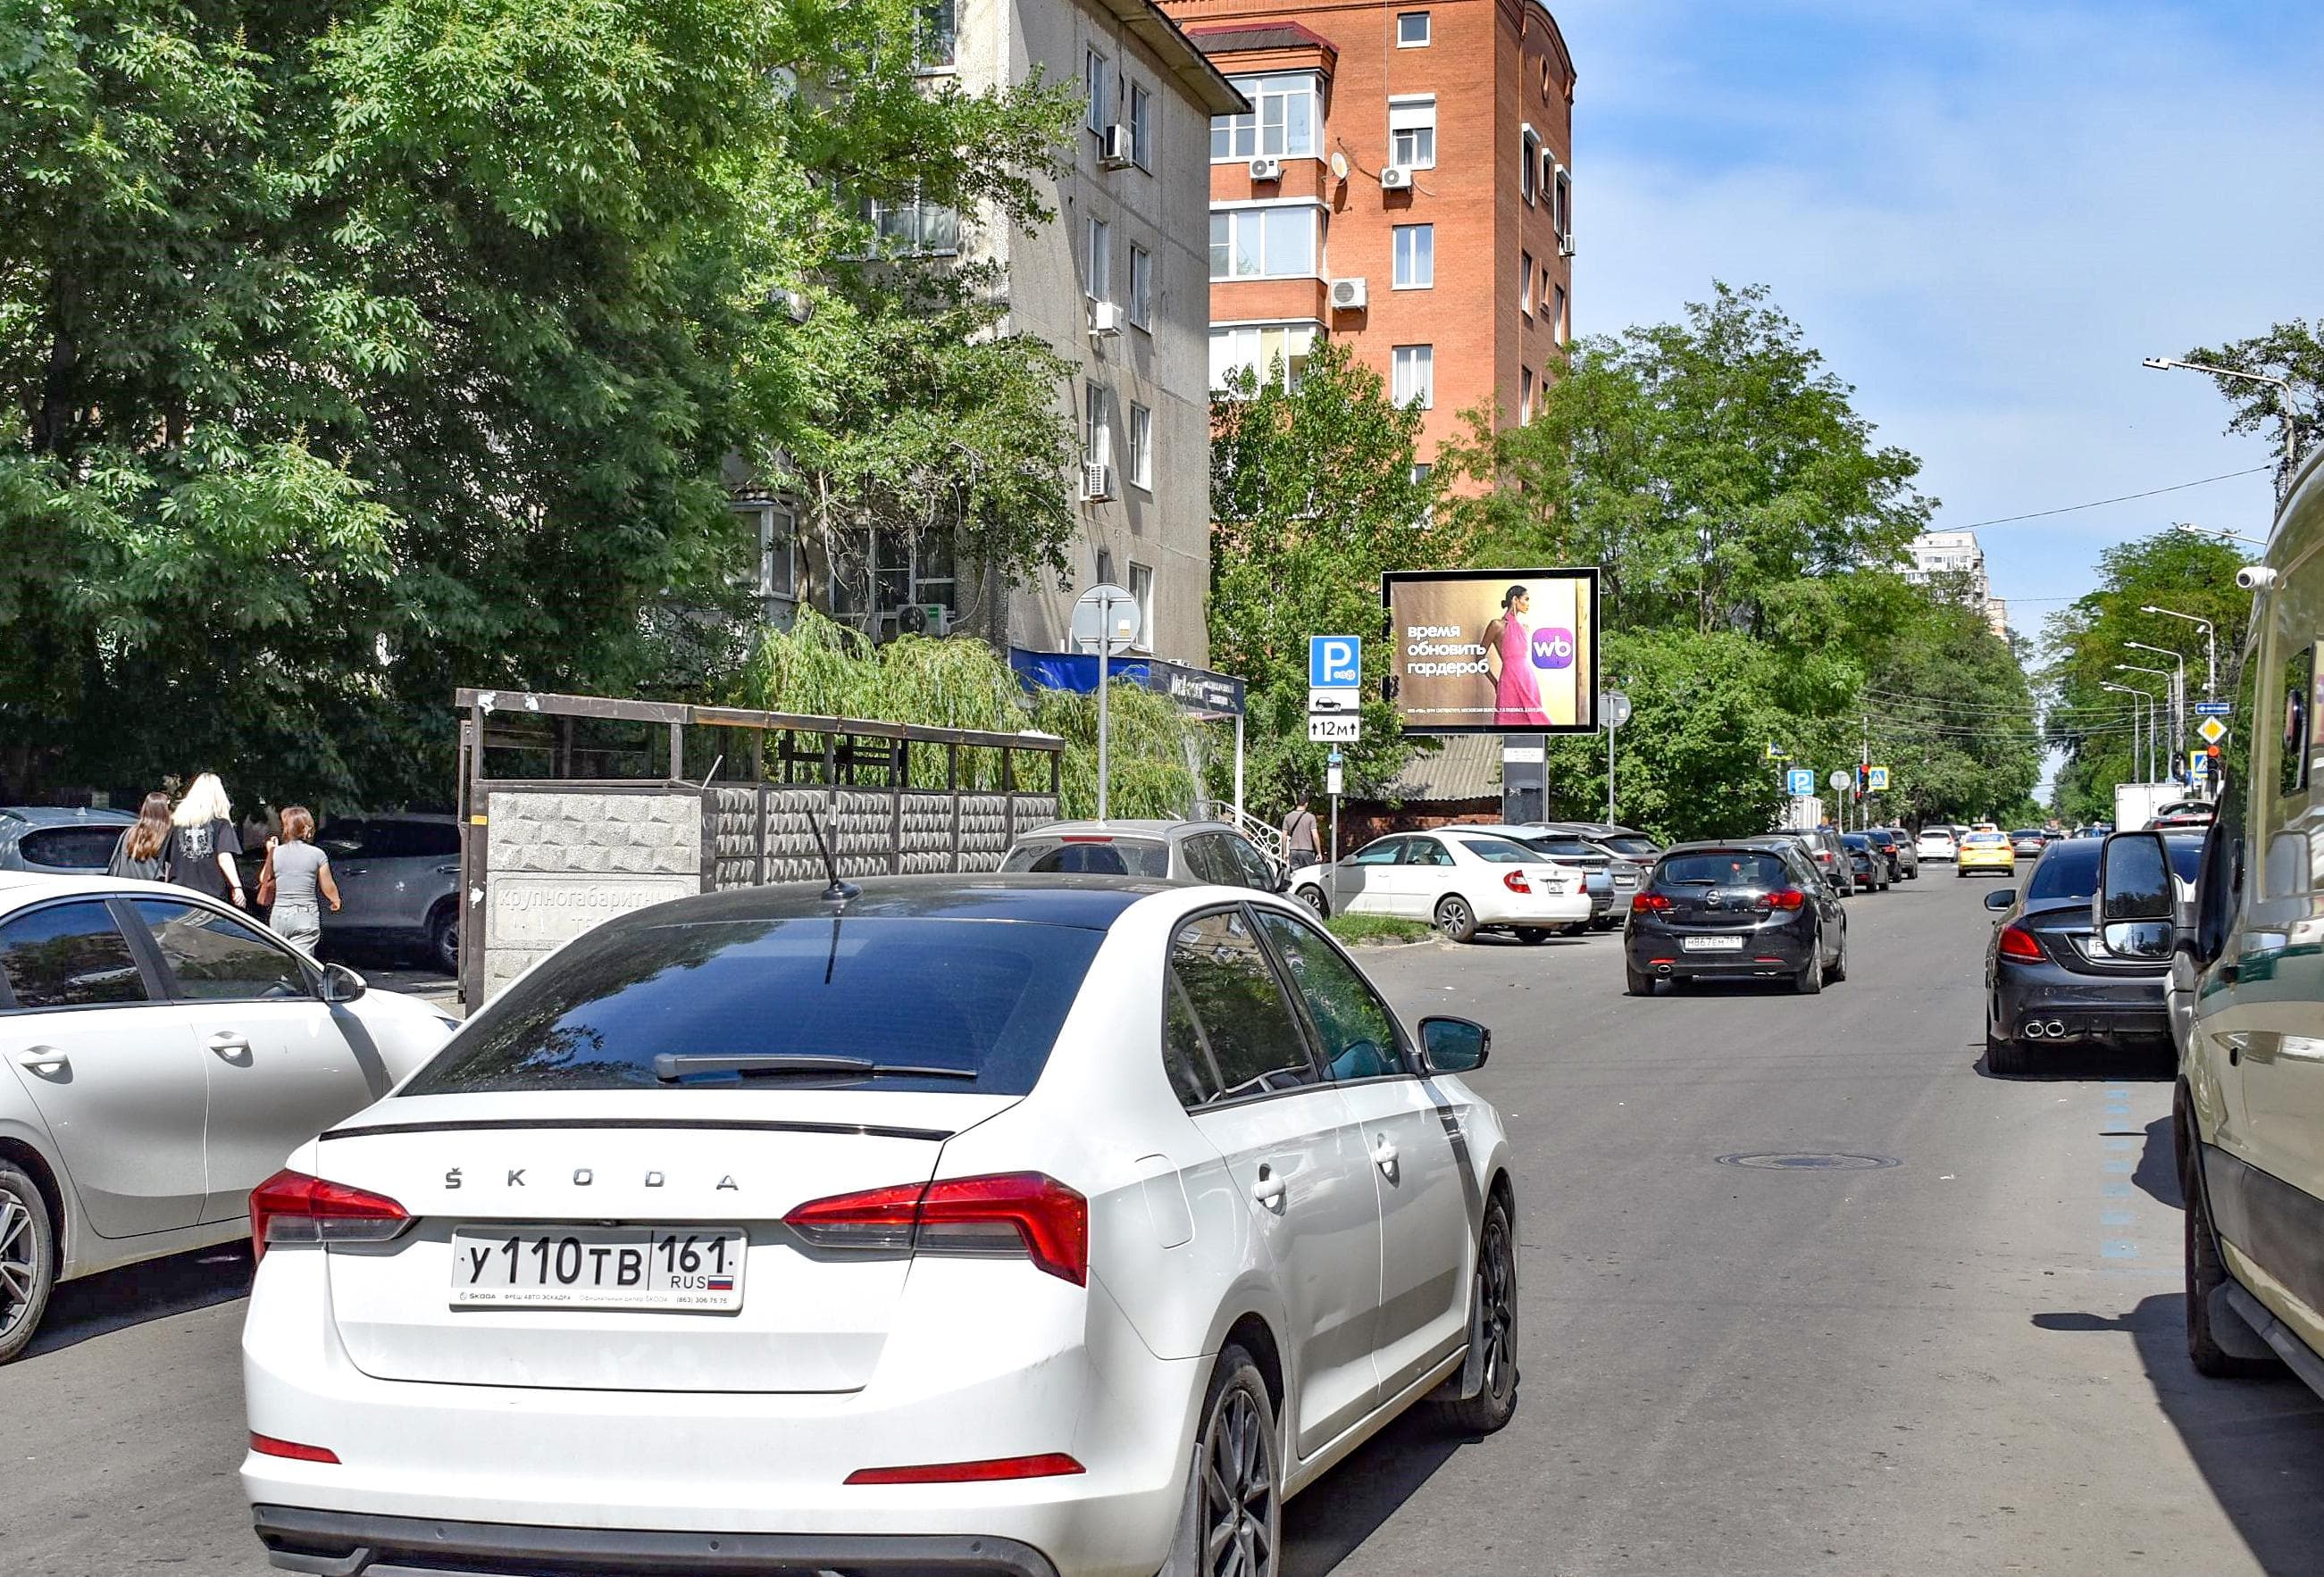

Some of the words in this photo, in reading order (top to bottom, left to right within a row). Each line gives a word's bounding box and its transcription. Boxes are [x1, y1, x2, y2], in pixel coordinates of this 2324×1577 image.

[1407, 625, 1461, 640] время
[1407, 641, 1486, 656] обновить
[1533, 635, 1572, 657] wb
[1324, 642, 1351, 682] P
[1407, 658, 1490, 678] гардероб
[445, 1167, 739, 1191] ŠKODA
[658, 1236, 727, 1273] 161
[671, 1276, 706, 1289] RUS
